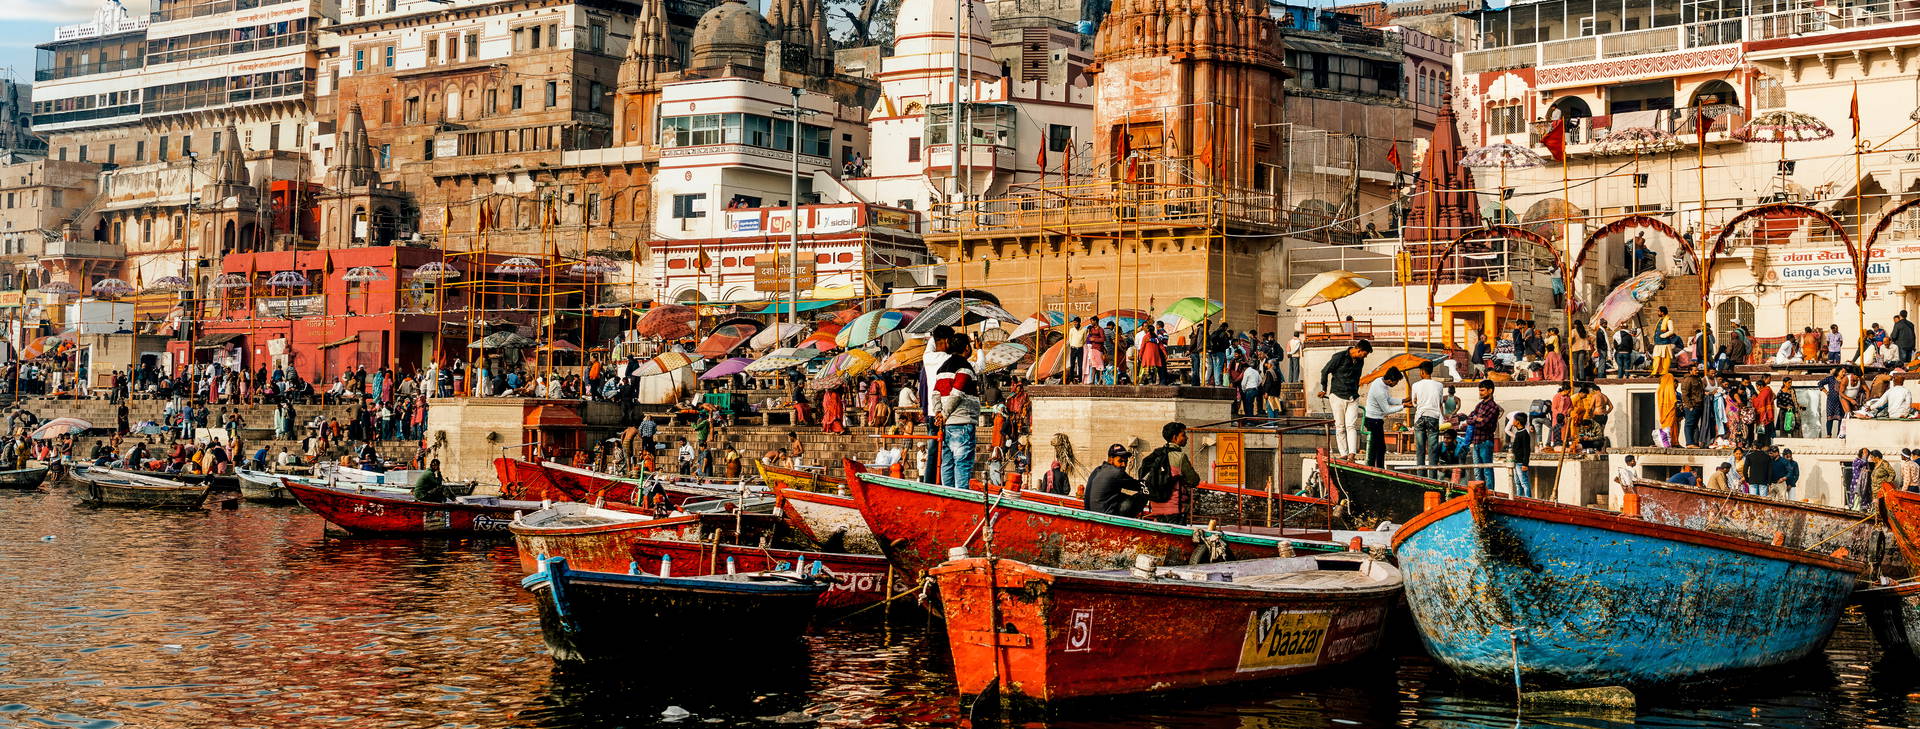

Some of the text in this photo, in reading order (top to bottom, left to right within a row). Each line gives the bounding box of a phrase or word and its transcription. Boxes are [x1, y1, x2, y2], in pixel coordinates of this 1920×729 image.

[830, 218, 851, 227] sidbi
[1783, 251, 1812, 262] गंगा
[1817, 250, 1845, 260] सेवा
[1783, 263, 1890, 279] Ganga Seva dhi
[1072, 612, 1090, 647] 5
[1268, 624, 1324, 657] baazar
